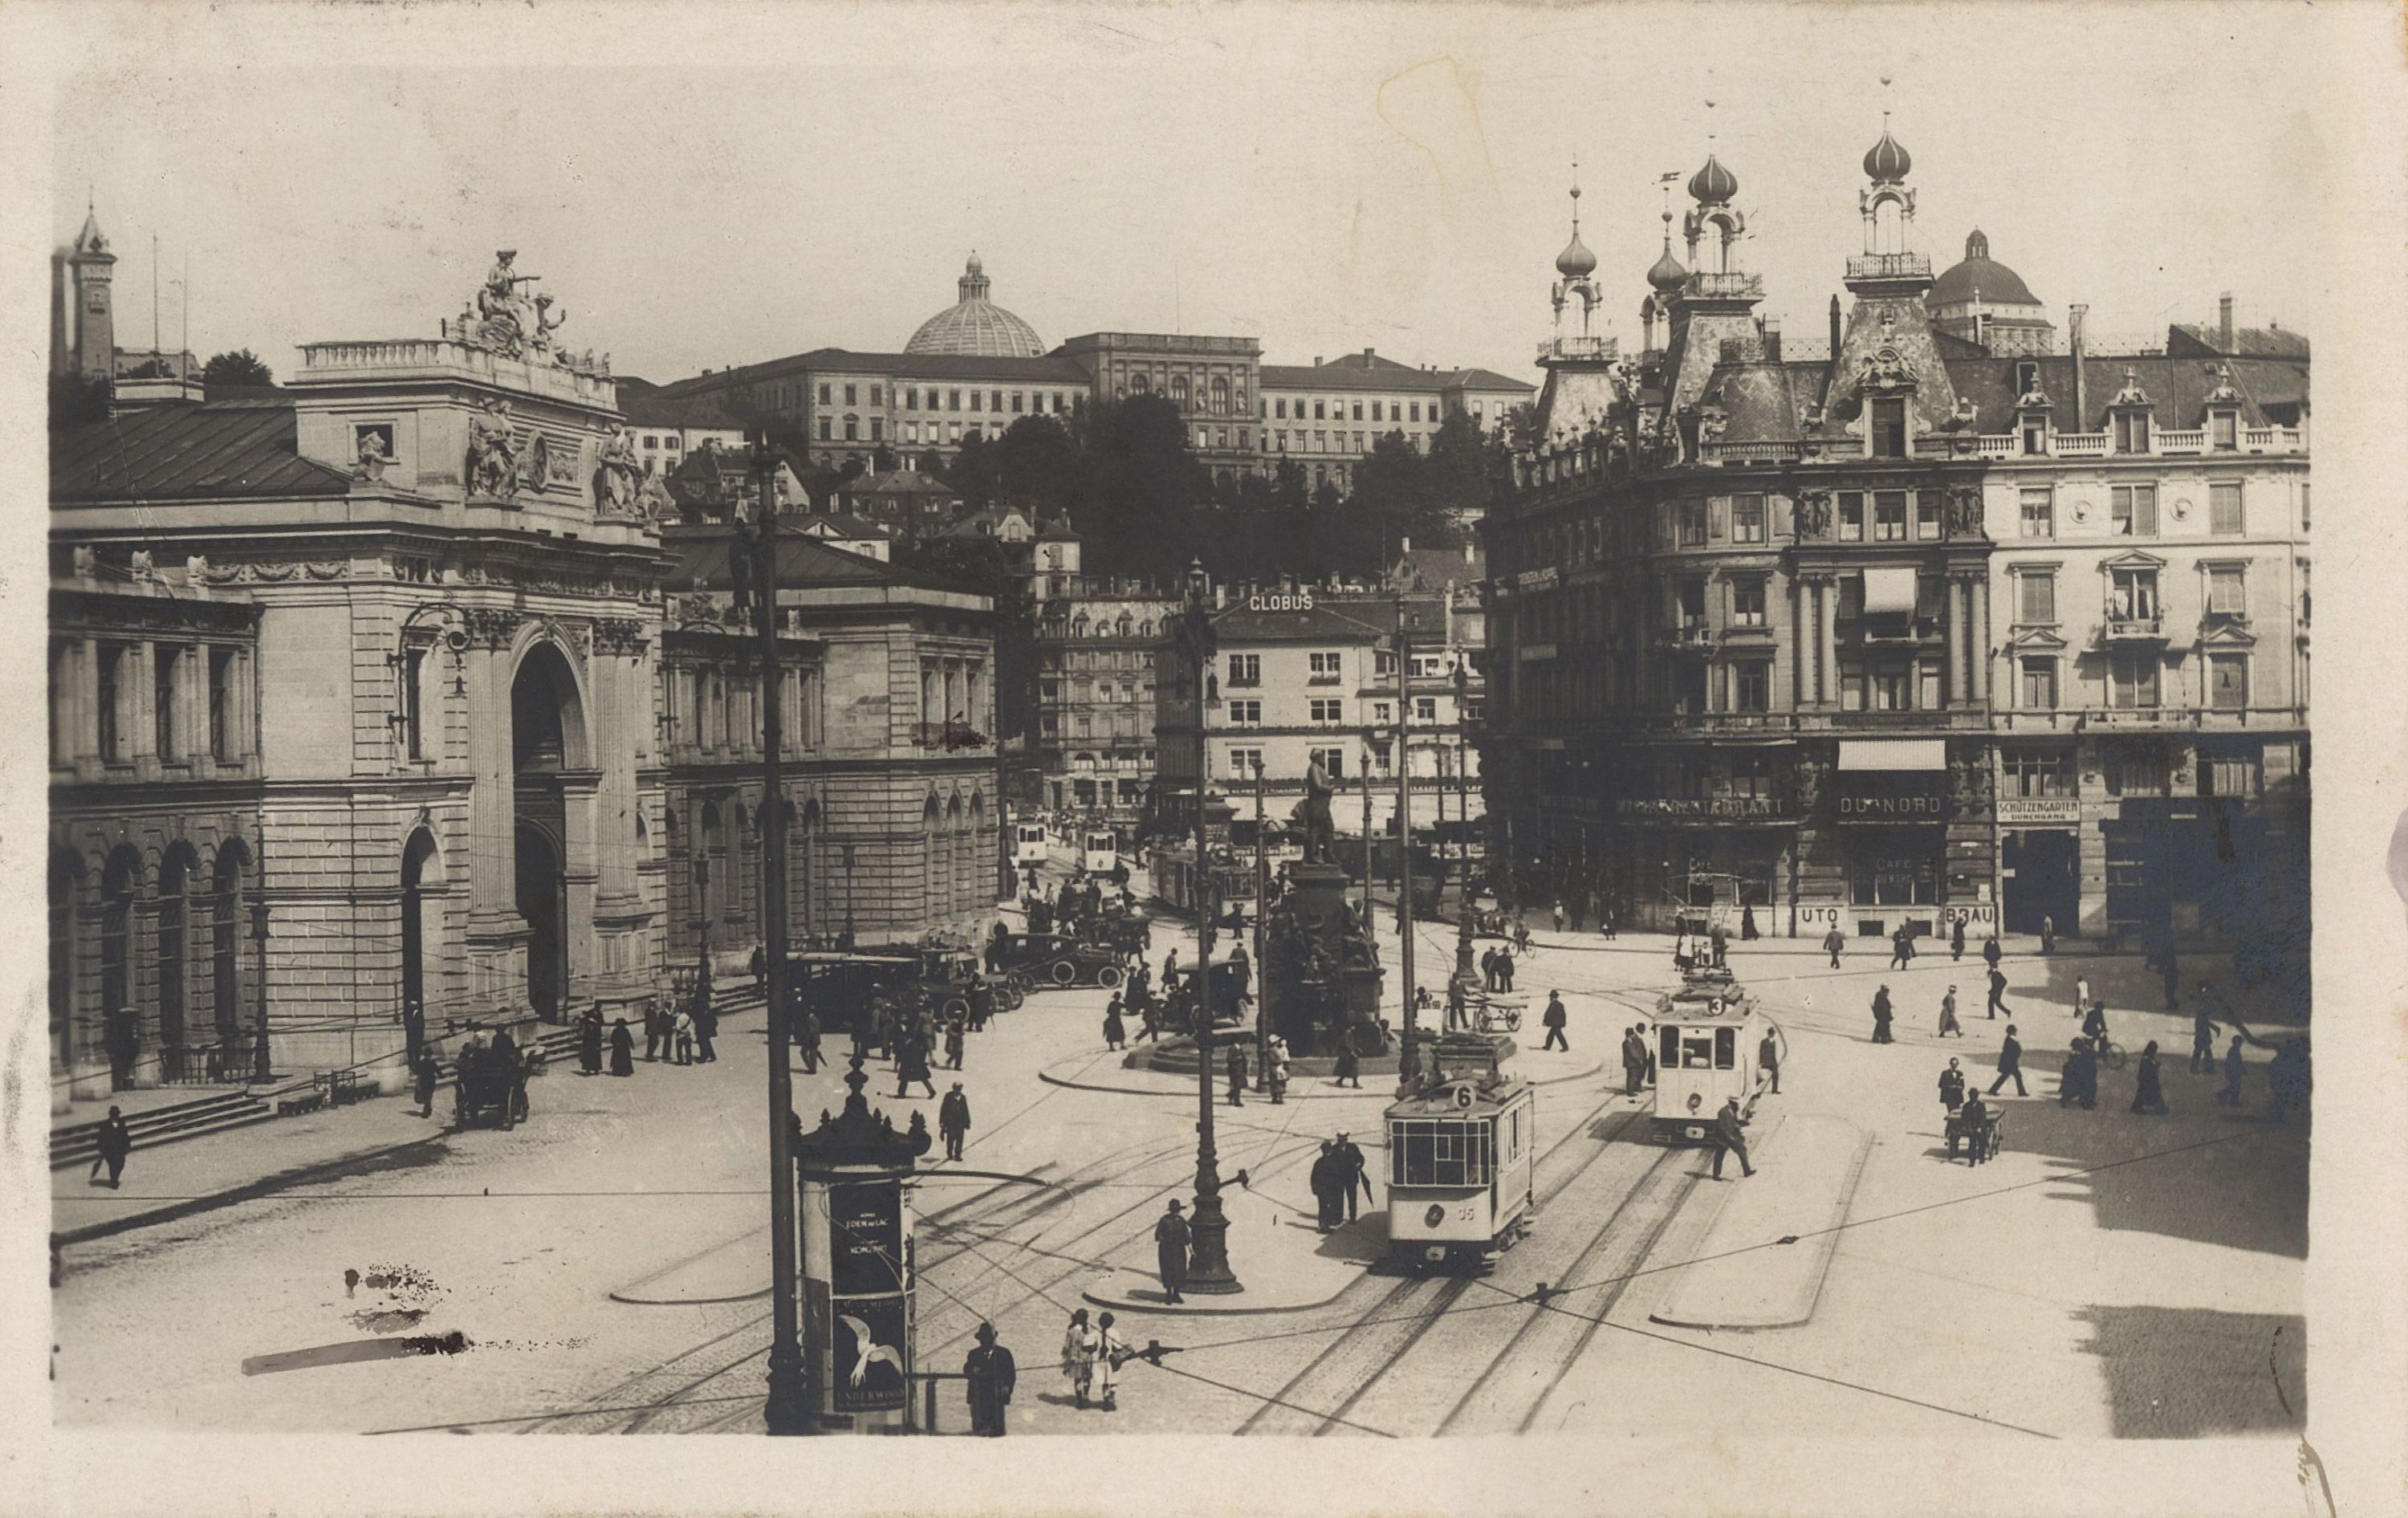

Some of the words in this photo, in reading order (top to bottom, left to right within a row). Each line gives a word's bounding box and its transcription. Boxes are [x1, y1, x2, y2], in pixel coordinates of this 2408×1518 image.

[1250, 595, 1314, 611] GLOBUS
[1841, 797, 1868, 813] DU
[1883, 797, 1941, 813] NORD
[1999, 800, 2078, 813] SCHÜTZENGARTEN
[1802, 908, 1838, 922] UTO
[1710, 998, 1723, 1015] 3
[1457, 1085, 1471, 1108] 6
